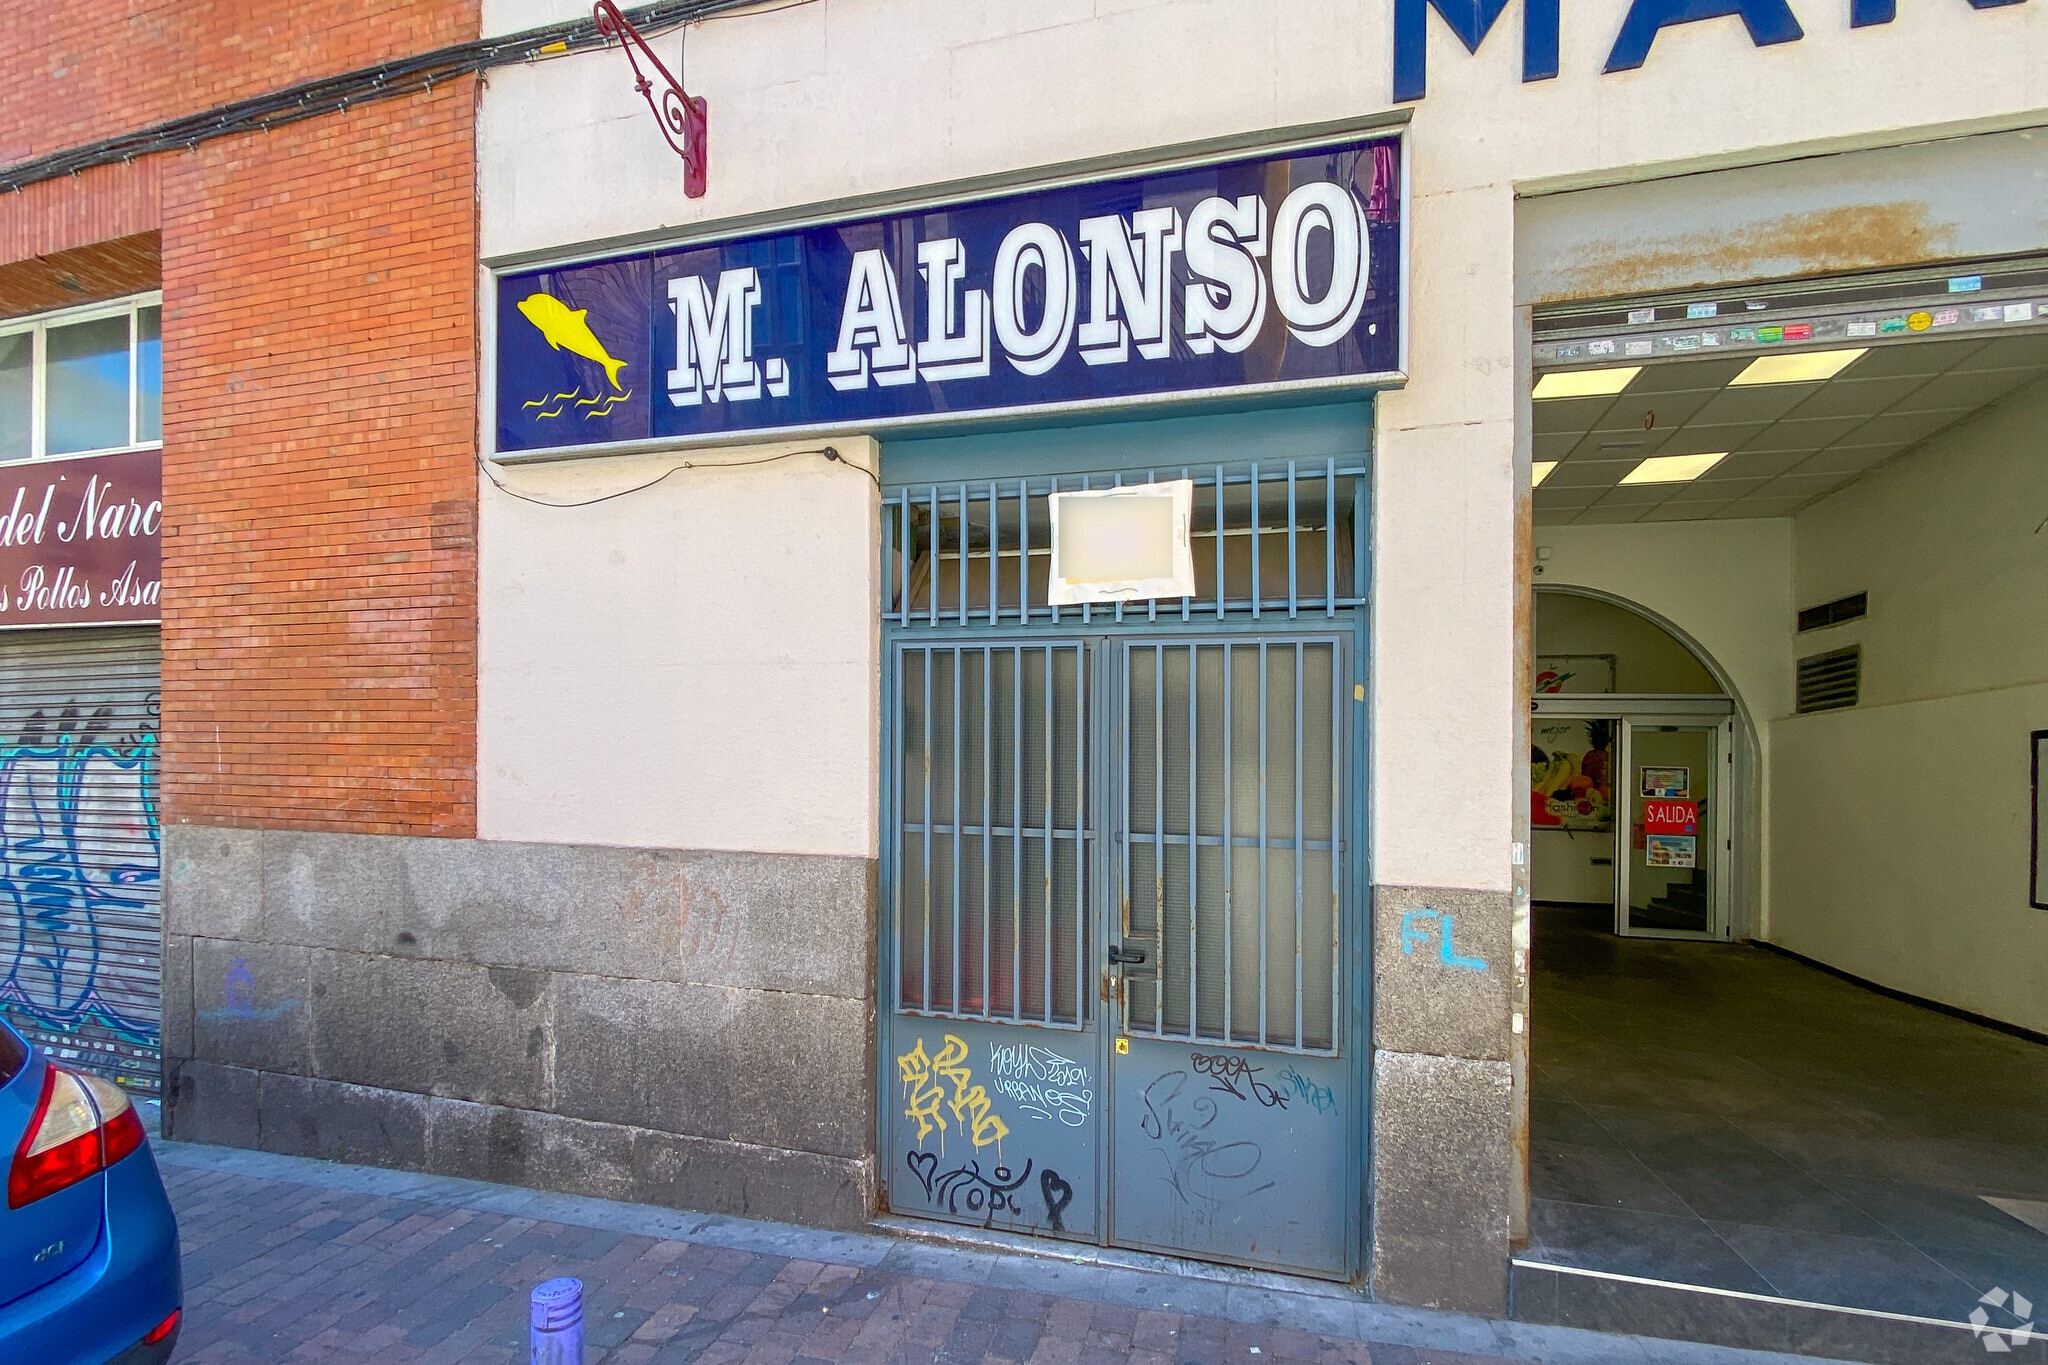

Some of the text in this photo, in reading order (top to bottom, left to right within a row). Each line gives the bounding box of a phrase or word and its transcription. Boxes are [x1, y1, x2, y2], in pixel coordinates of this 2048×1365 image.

[666, 181, 1370, 407] M. ALONSO
[57, 474, 162, 542] Narc
[17, 564, 92, 612] Pollos
[99, 559, 161, 607] Asa
[1540, 723, 1571, 744] mejor
[1647, 805, 1696, 823] SALIDA
